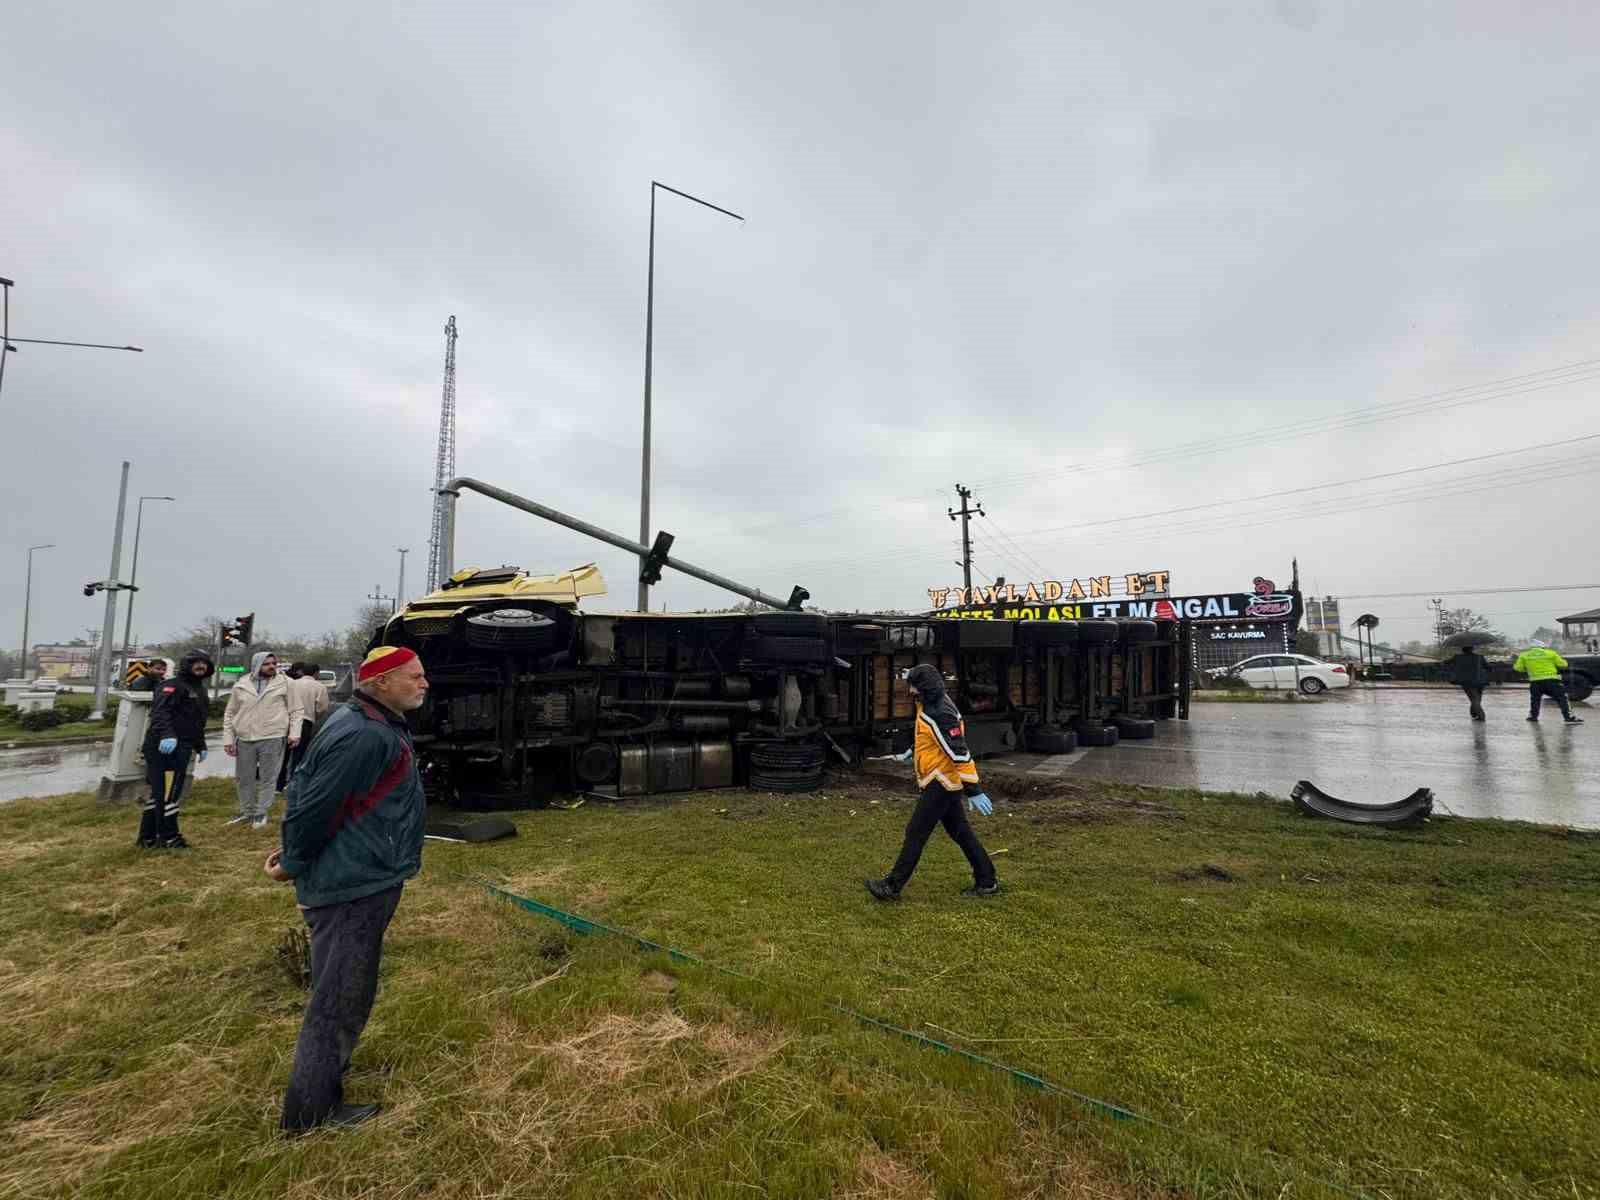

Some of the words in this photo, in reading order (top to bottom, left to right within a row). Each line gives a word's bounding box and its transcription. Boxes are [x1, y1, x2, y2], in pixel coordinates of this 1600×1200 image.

[952, 576, 1111, 605] YAYLADAN
[1126, 570, 1169, 595] ET
[1093, 603, 1121, 618] ET
